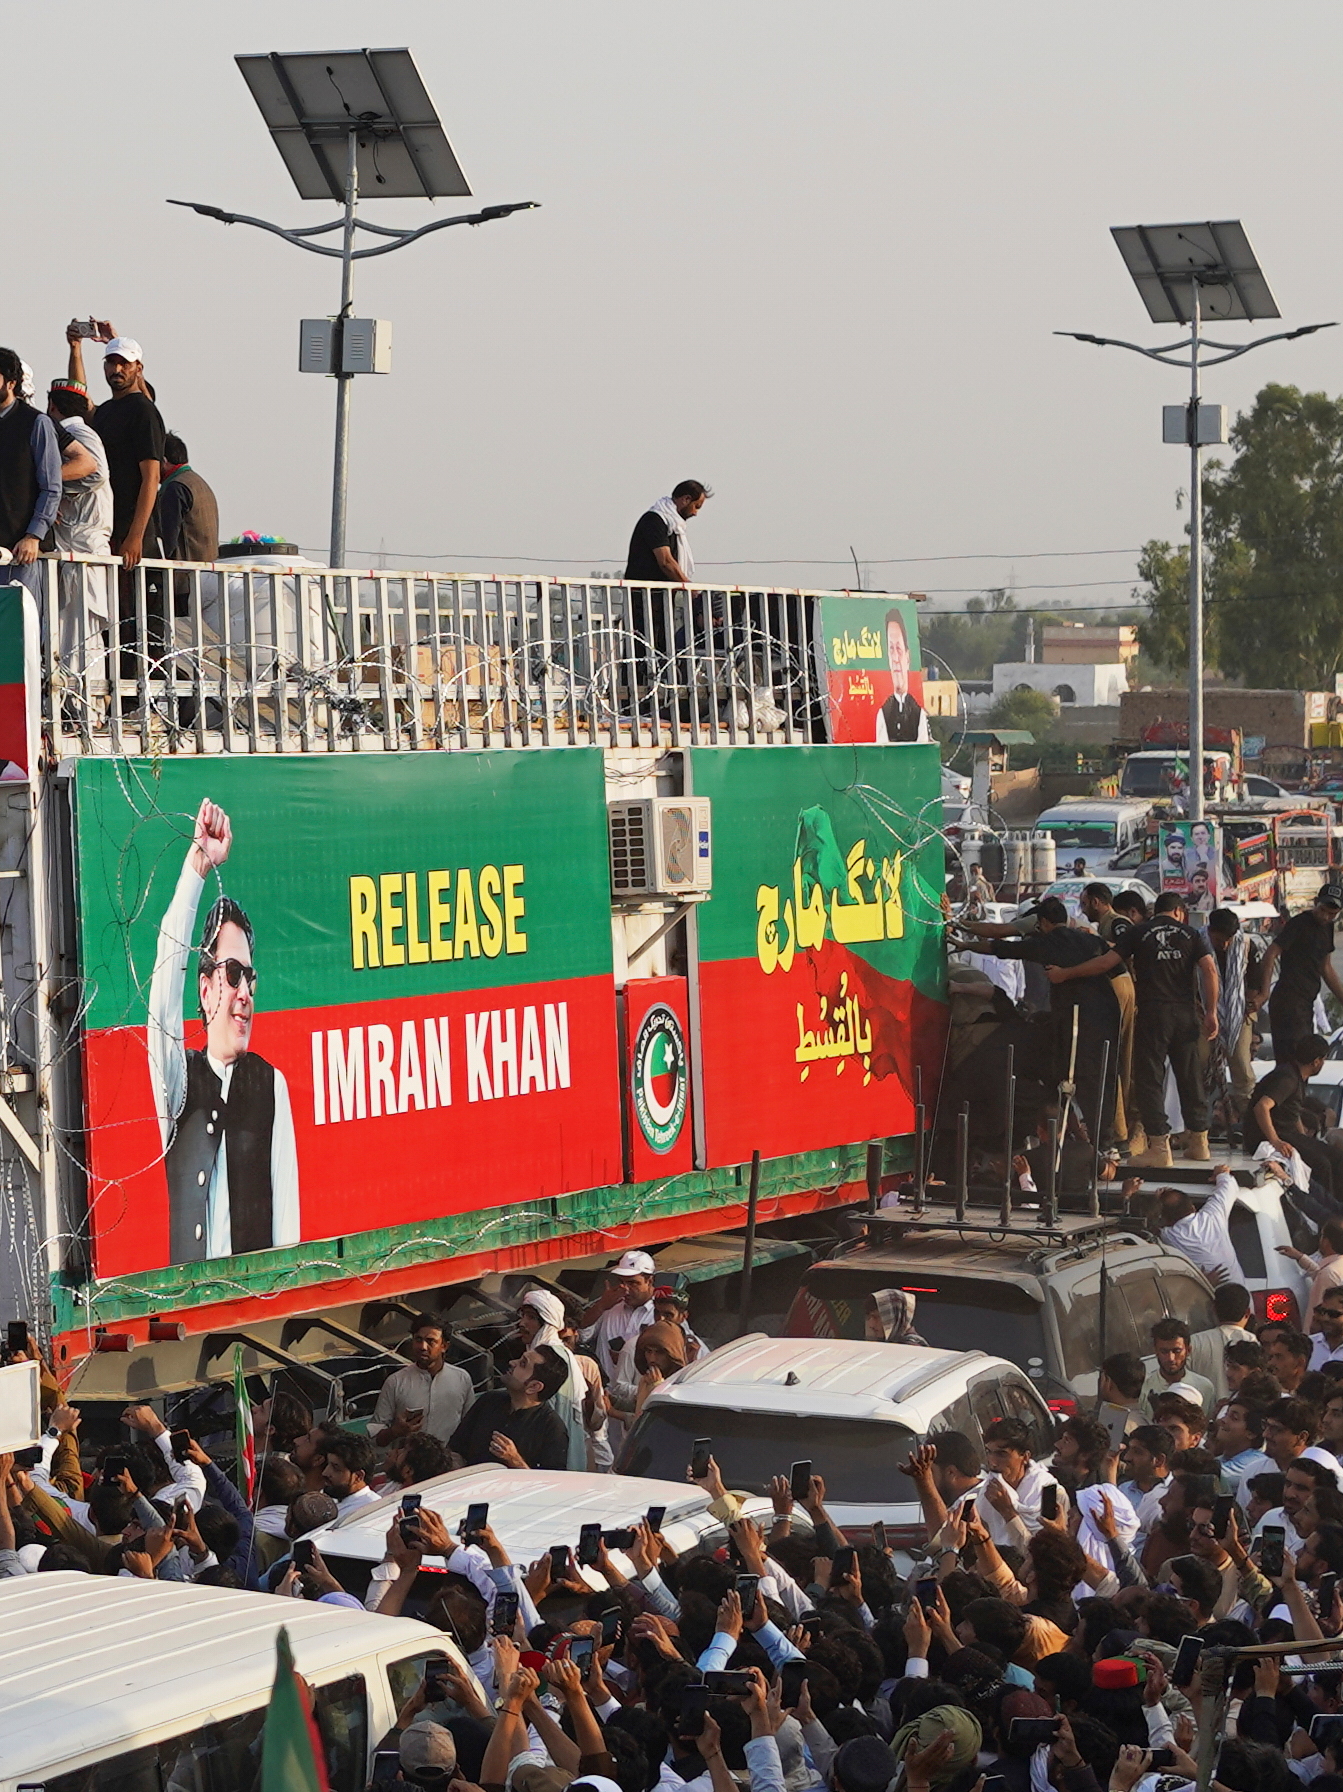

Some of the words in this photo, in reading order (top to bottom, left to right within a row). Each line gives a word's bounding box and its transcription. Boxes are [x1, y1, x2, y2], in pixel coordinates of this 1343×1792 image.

[832, 630, 857, 665] مارچ
[857, 626, 883, 659] لانگ
[349, 864, 527, 970] RELEASE
[756, 856, 827, 974] مارچ
[831, 839, 905, 944] لانگ
[311, 1016, 452, 1126] IMRAN
[466, 1001, 572, 1103] KHAN
